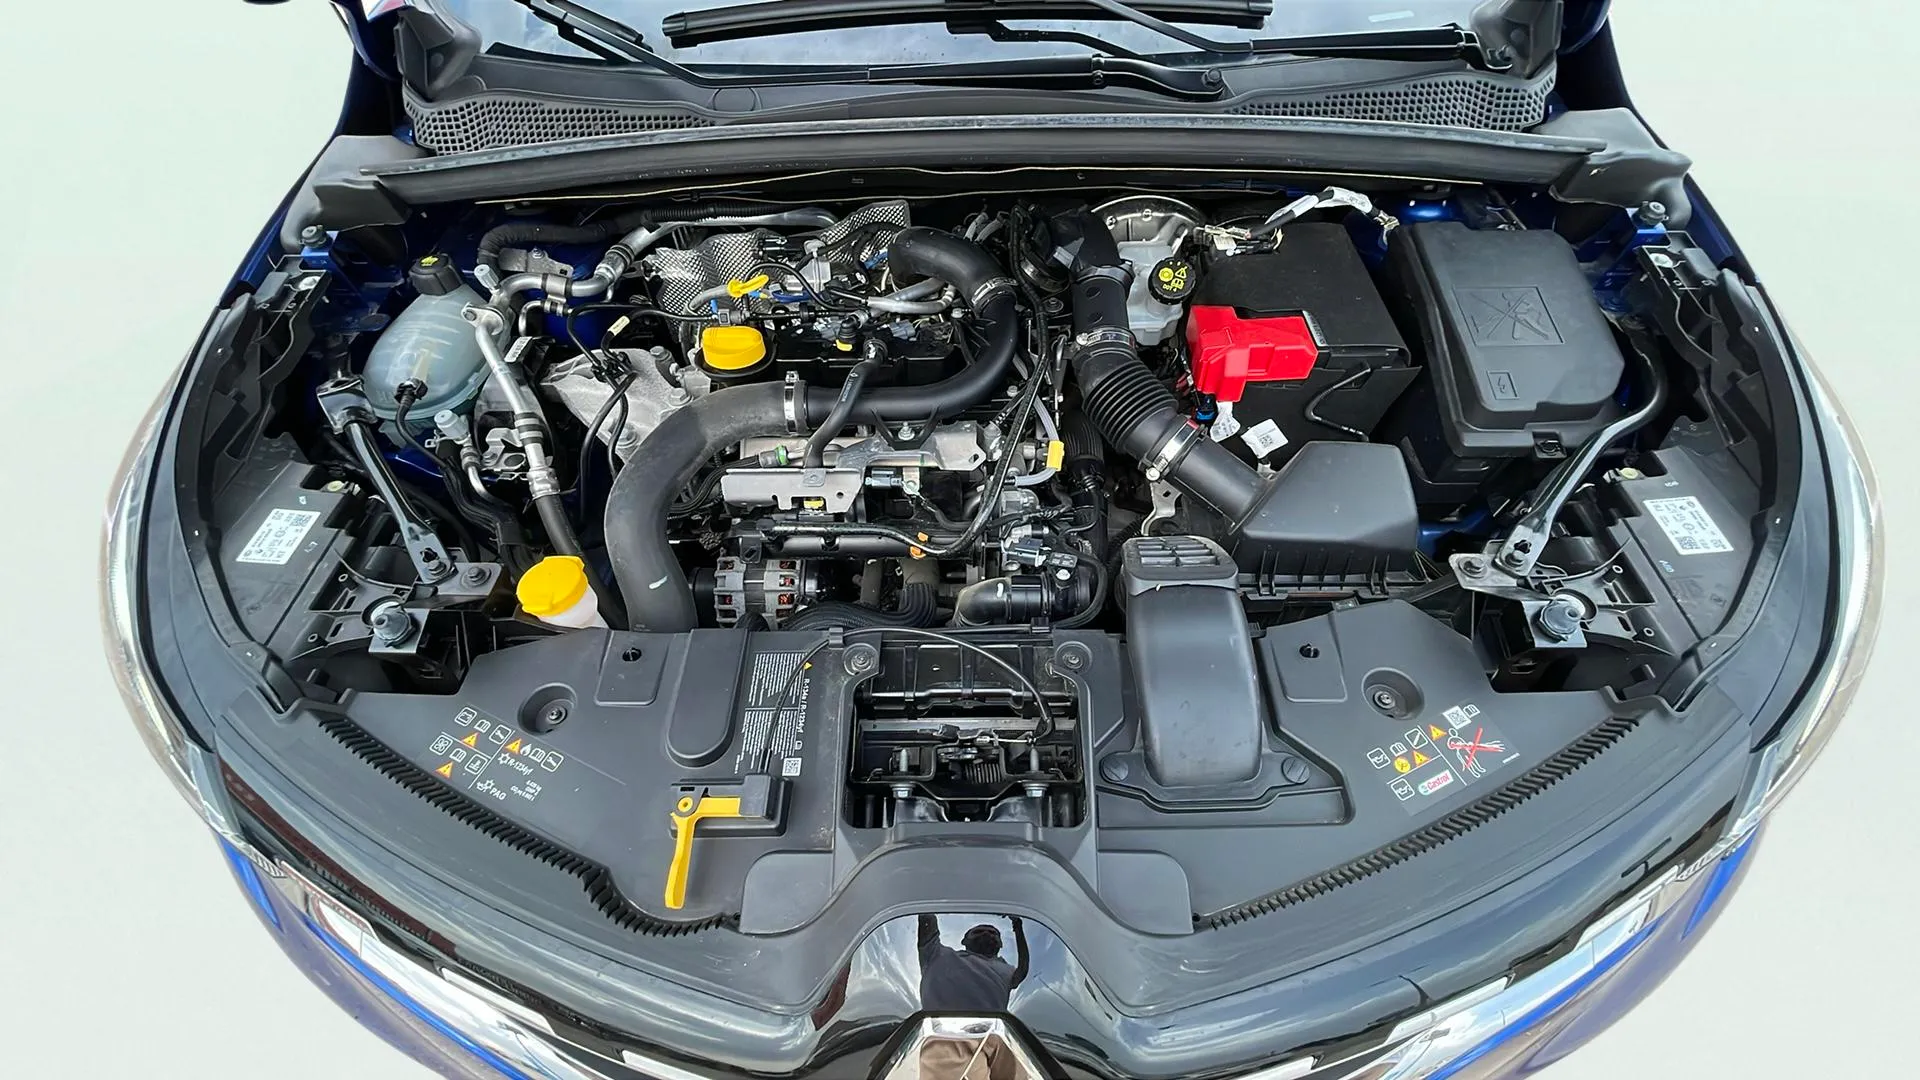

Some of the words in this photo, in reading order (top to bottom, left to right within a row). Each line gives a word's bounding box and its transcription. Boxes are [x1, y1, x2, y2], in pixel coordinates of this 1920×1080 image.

[801, 678, 810, 700] R-134a
[796, 704, 807, 733] R-1234yf
[1427, 773, 1450, 789] Castrol
